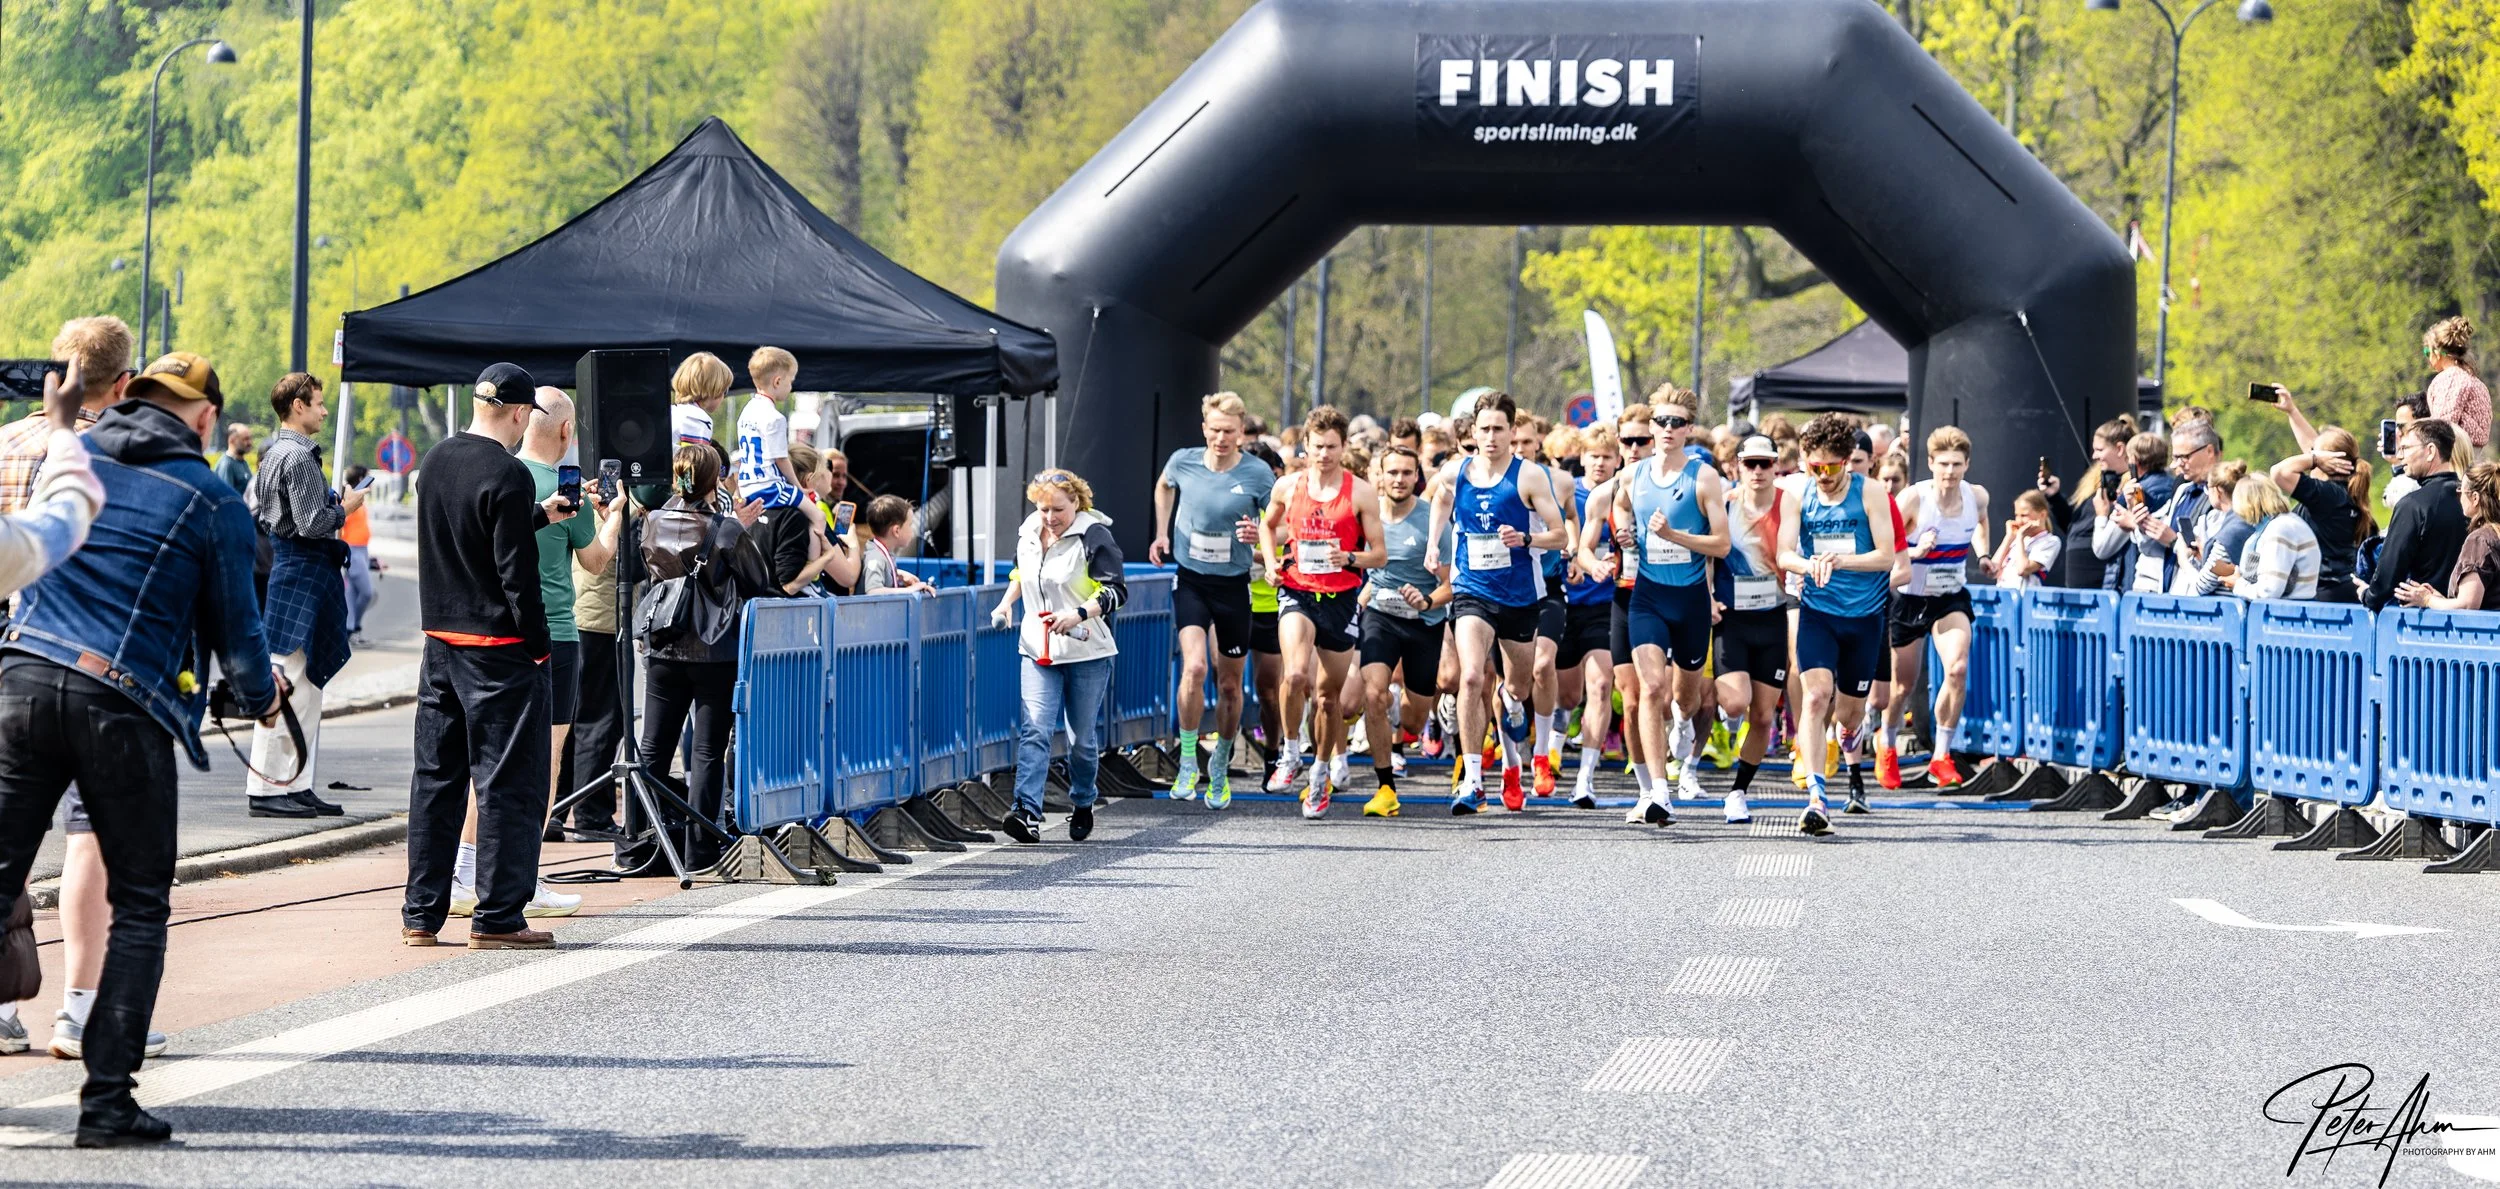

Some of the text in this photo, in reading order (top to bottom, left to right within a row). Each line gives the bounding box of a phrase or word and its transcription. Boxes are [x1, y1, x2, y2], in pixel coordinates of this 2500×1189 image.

[1439, 58, 1675, 108] FINISH
[1473, 123, 1638, 145] sportstiming.dk
[1807, 519, 1858, 530] SPARTA
